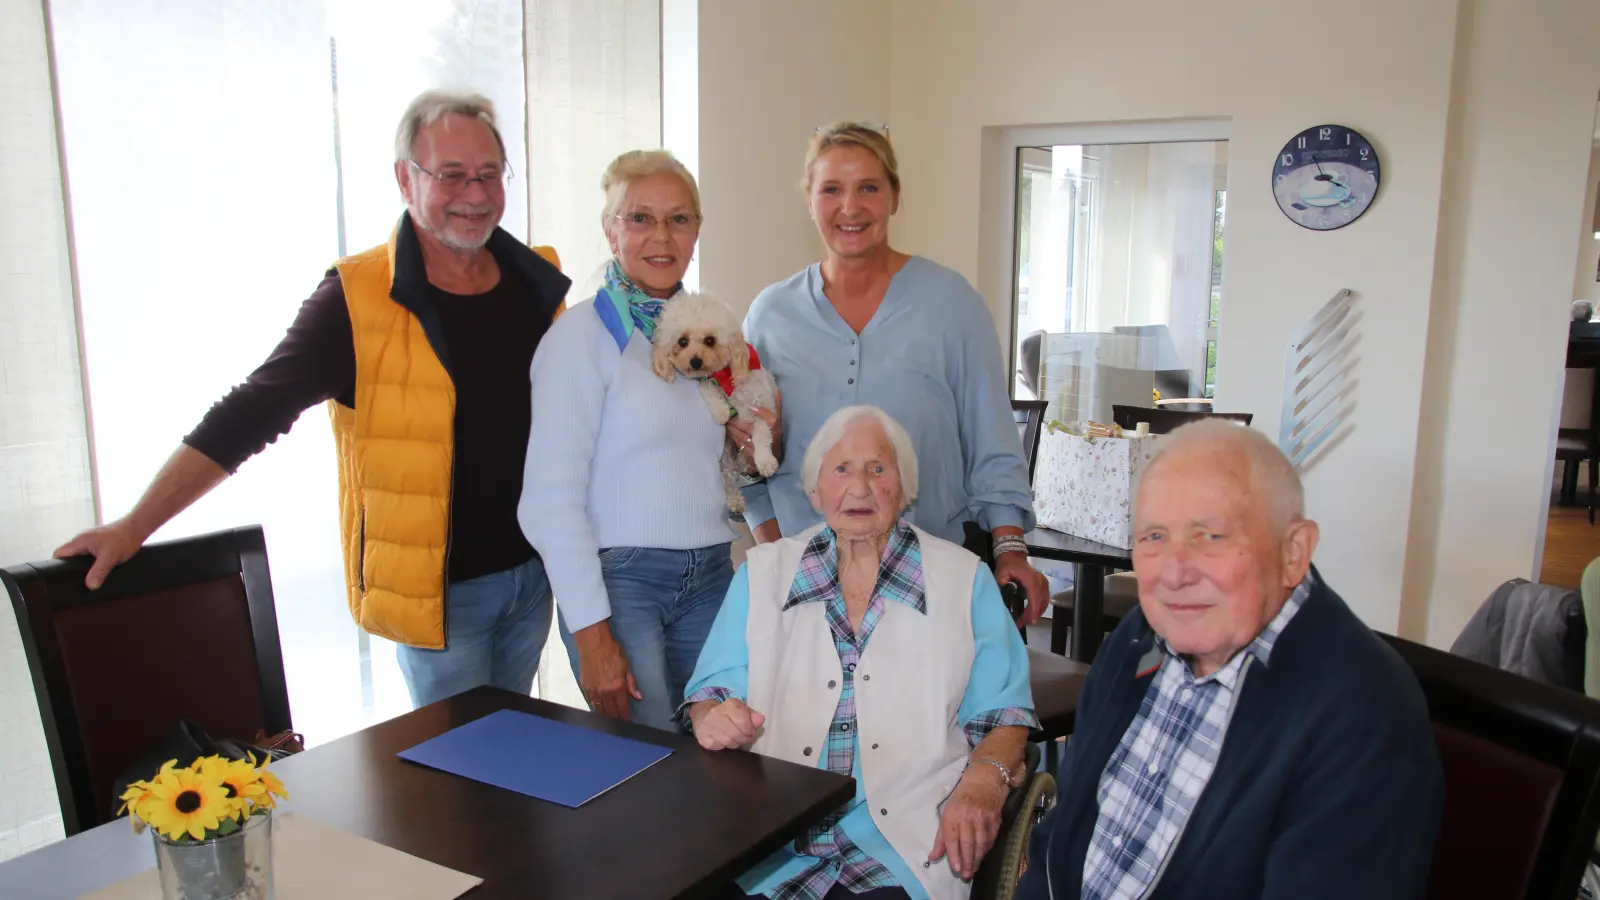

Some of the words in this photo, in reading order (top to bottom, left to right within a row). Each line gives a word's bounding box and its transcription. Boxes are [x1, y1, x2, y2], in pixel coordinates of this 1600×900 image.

[1319, 128, 1331, 140] 12
[1346, 133, 1351, 145] 1
[1298, 136, 1306, 149] 11
[1281, 153, 1294, 166] 10
[1360, 148, 1369, 160] 2
